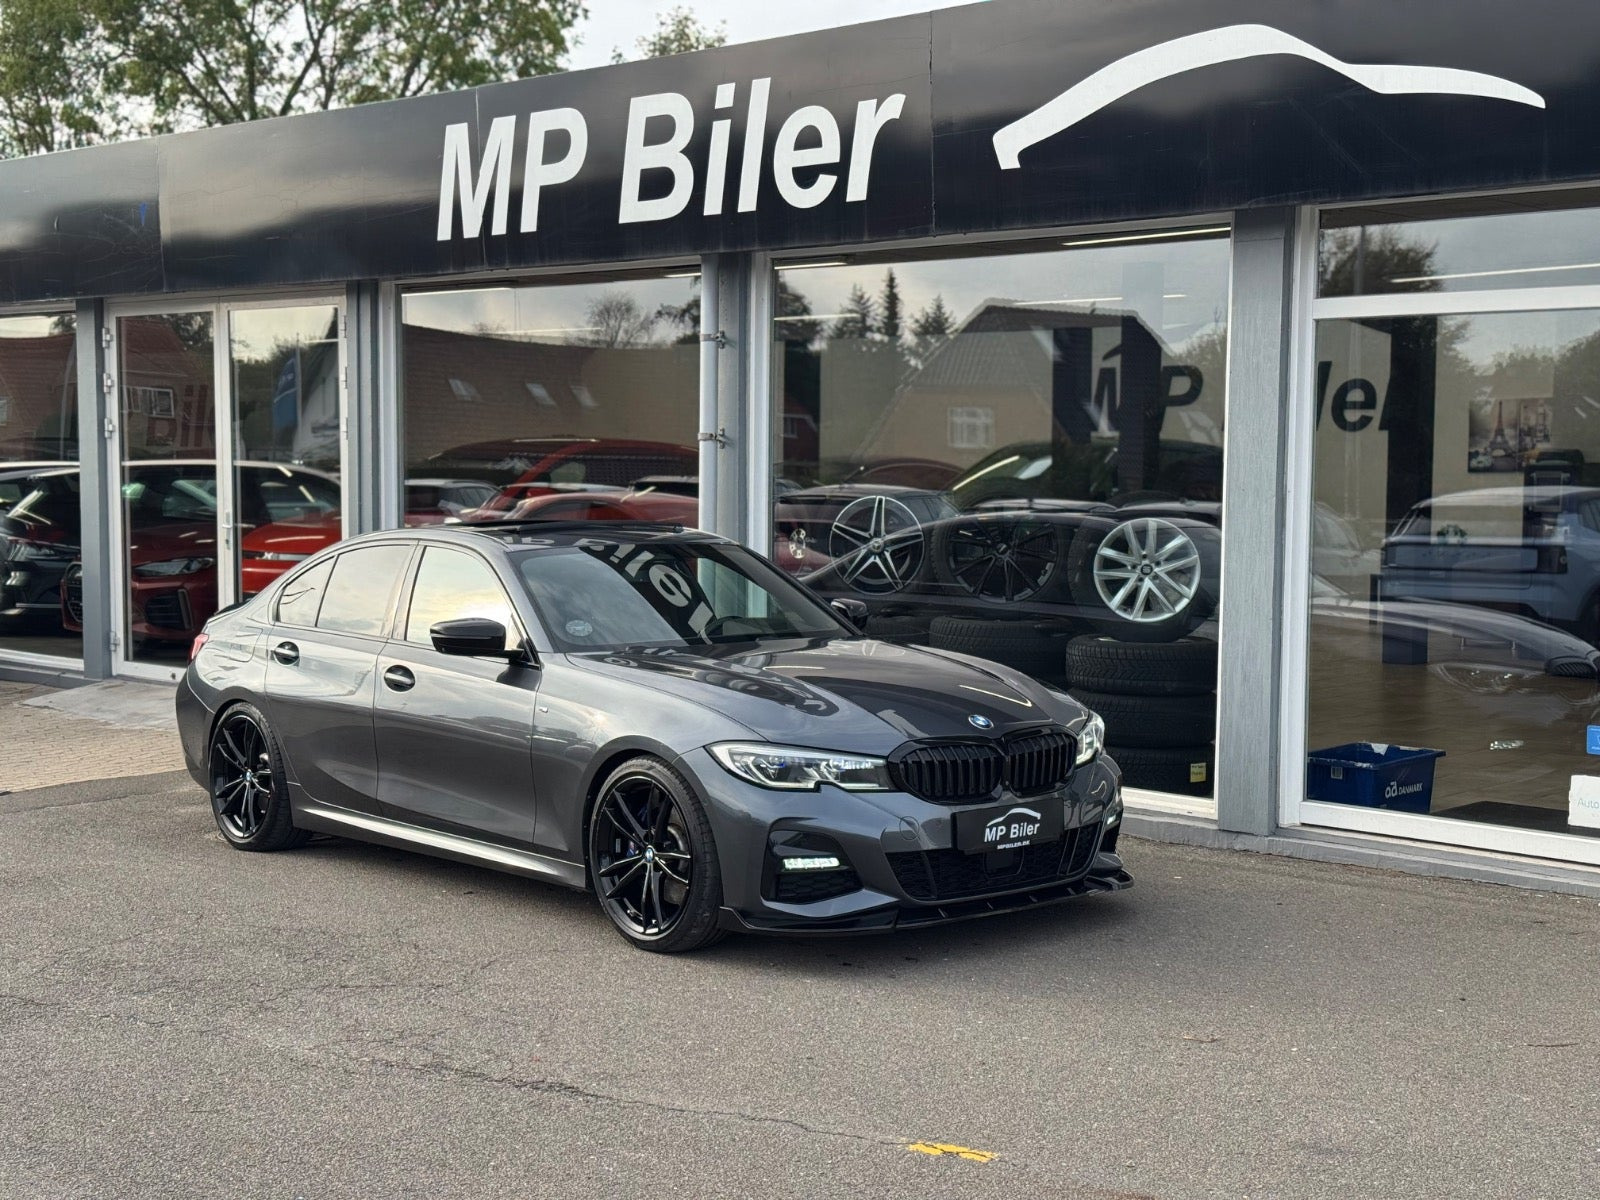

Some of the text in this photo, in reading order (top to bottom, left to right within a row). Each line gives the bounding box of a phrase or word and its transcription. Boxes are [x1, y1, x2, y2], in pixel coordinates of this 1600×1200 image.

[437, 77, 906, 241] MP Biler
[1398, 782, 1423, 795] DANMARK
[984, 821, 1040, 843] MP Biler
